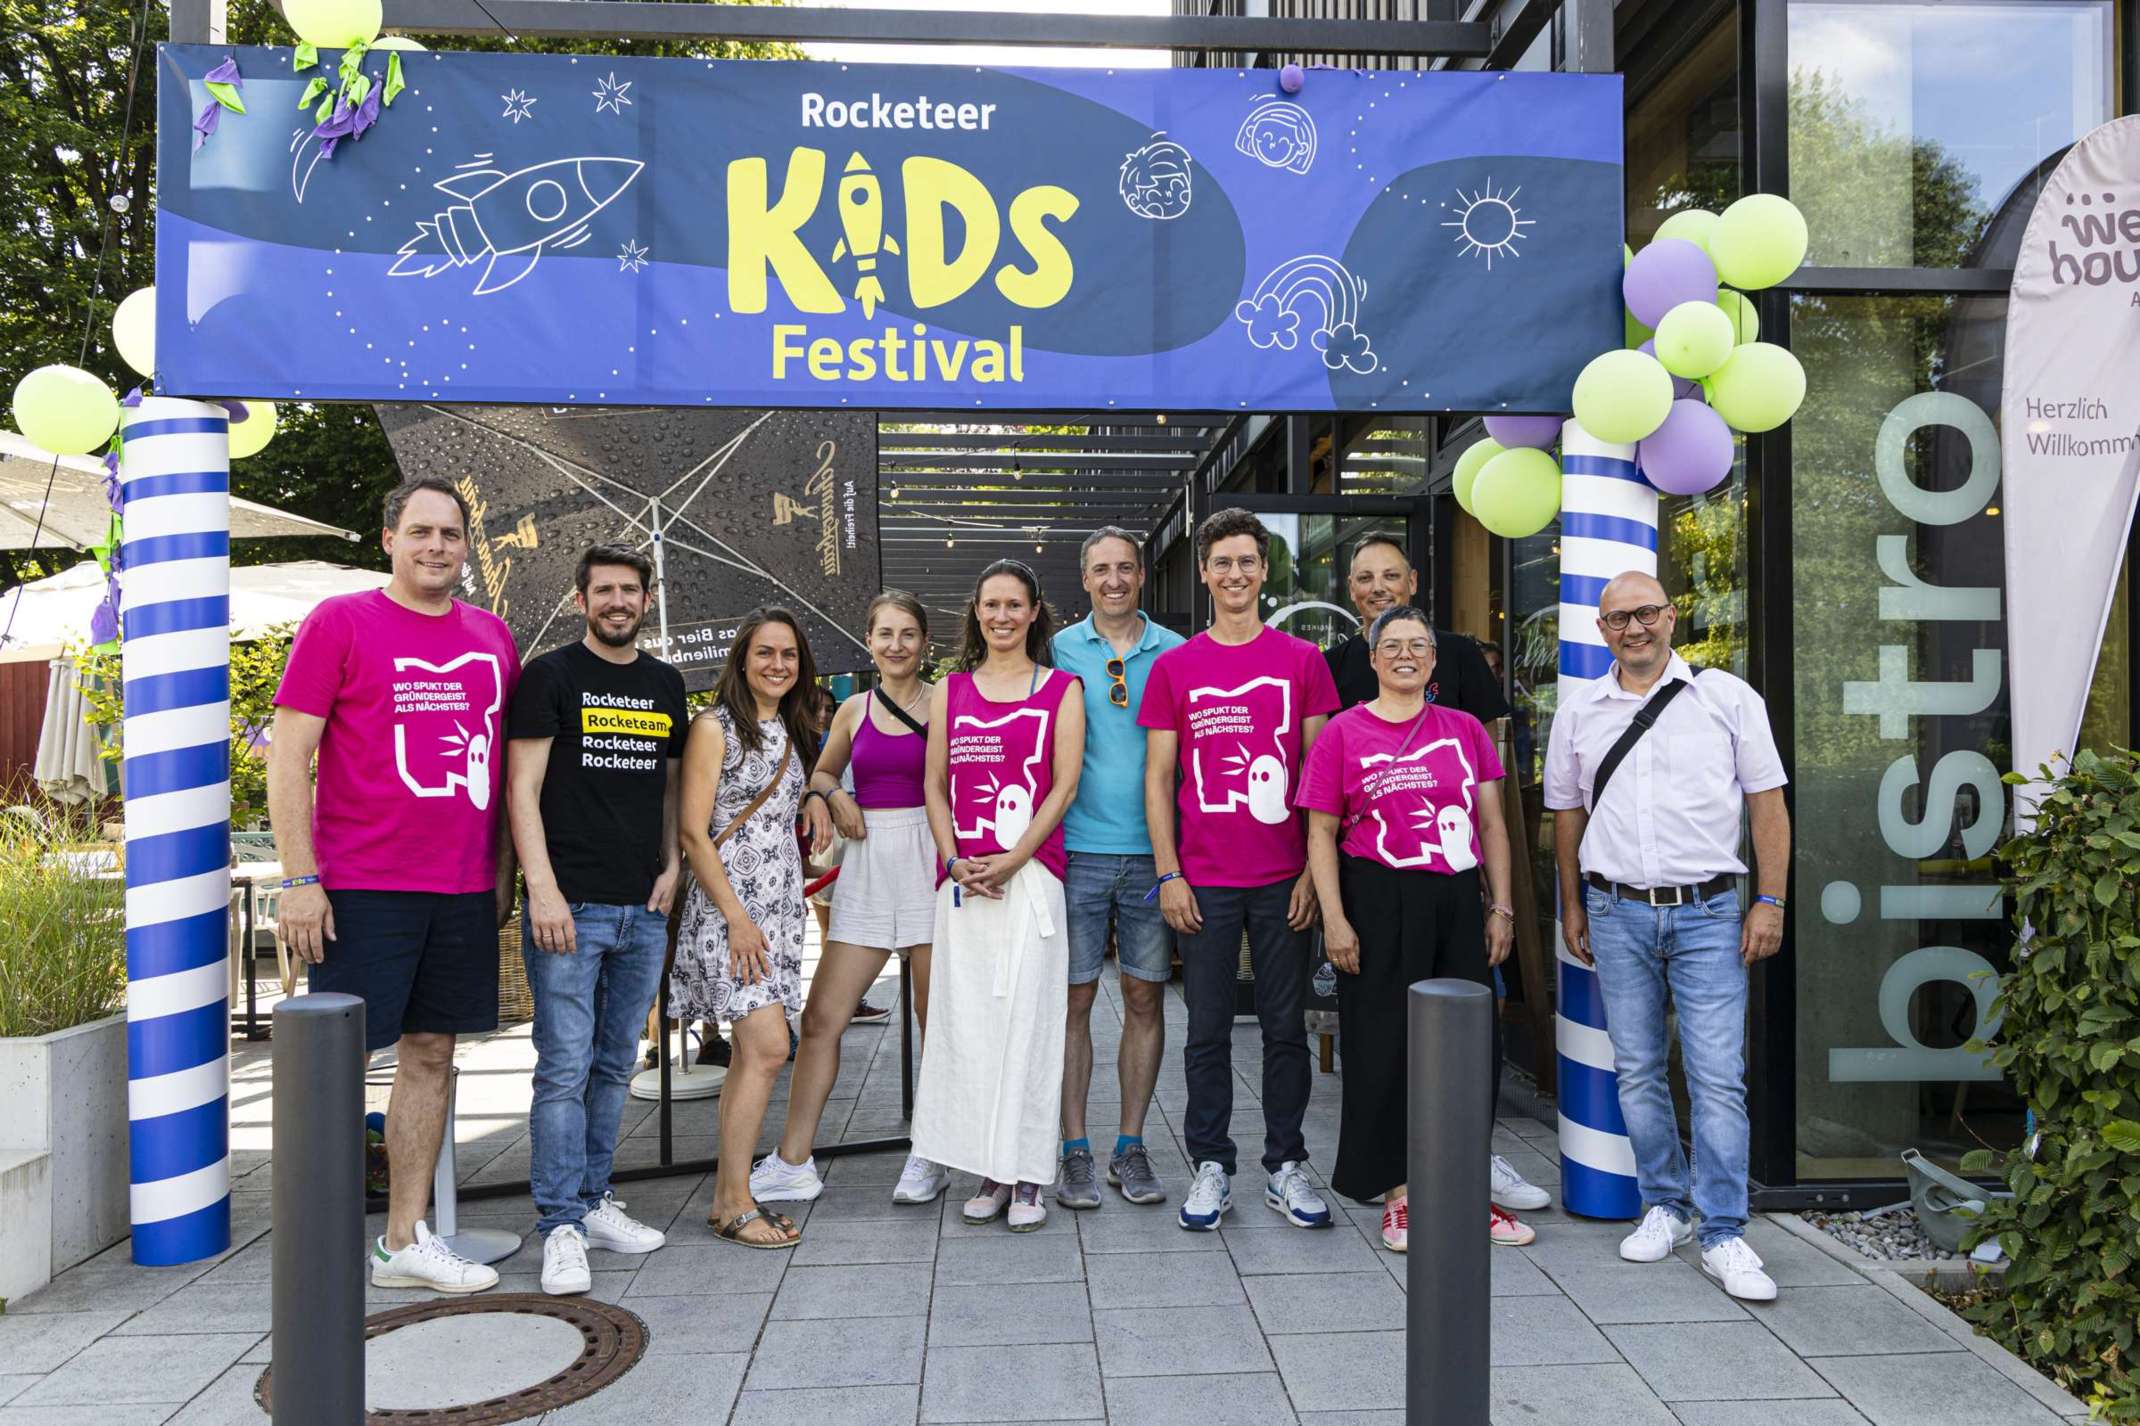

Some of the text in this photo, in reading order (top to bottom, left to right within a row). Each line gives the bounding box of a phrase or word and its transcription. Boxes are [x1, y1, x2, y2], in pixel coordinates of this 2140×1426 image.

[801, 93, 997, 130] Rocketeer
[772, 323, 1024, 382] Festival
[2026, 397, 2108, 420] Herzlich
[2027, 432, 2140, 457] Willkomm
[393, 681, 463, 692] WO SPUKT DER
[394, 691, 467, 703] GRÜNDERGEIST
[582, 692, 655, 710] Rocketeer
[394, 701, 470, 714] ALS NÄCHSTES?
[1231, 706, 1249, 714] DER
[588, 714, 667, 732] Rocketeam
[1205, 725, 1255, 736] NÄCHSTES?
[582, 735, 657, 752] Rocketeer
[1821, 391, 2004, 1082] bistro
[582, 753, 657, 770] Rocketeer
[1361, 773, 1378, 784] WO
[1383, 780, 1438, 795] NÄCHSTES?
